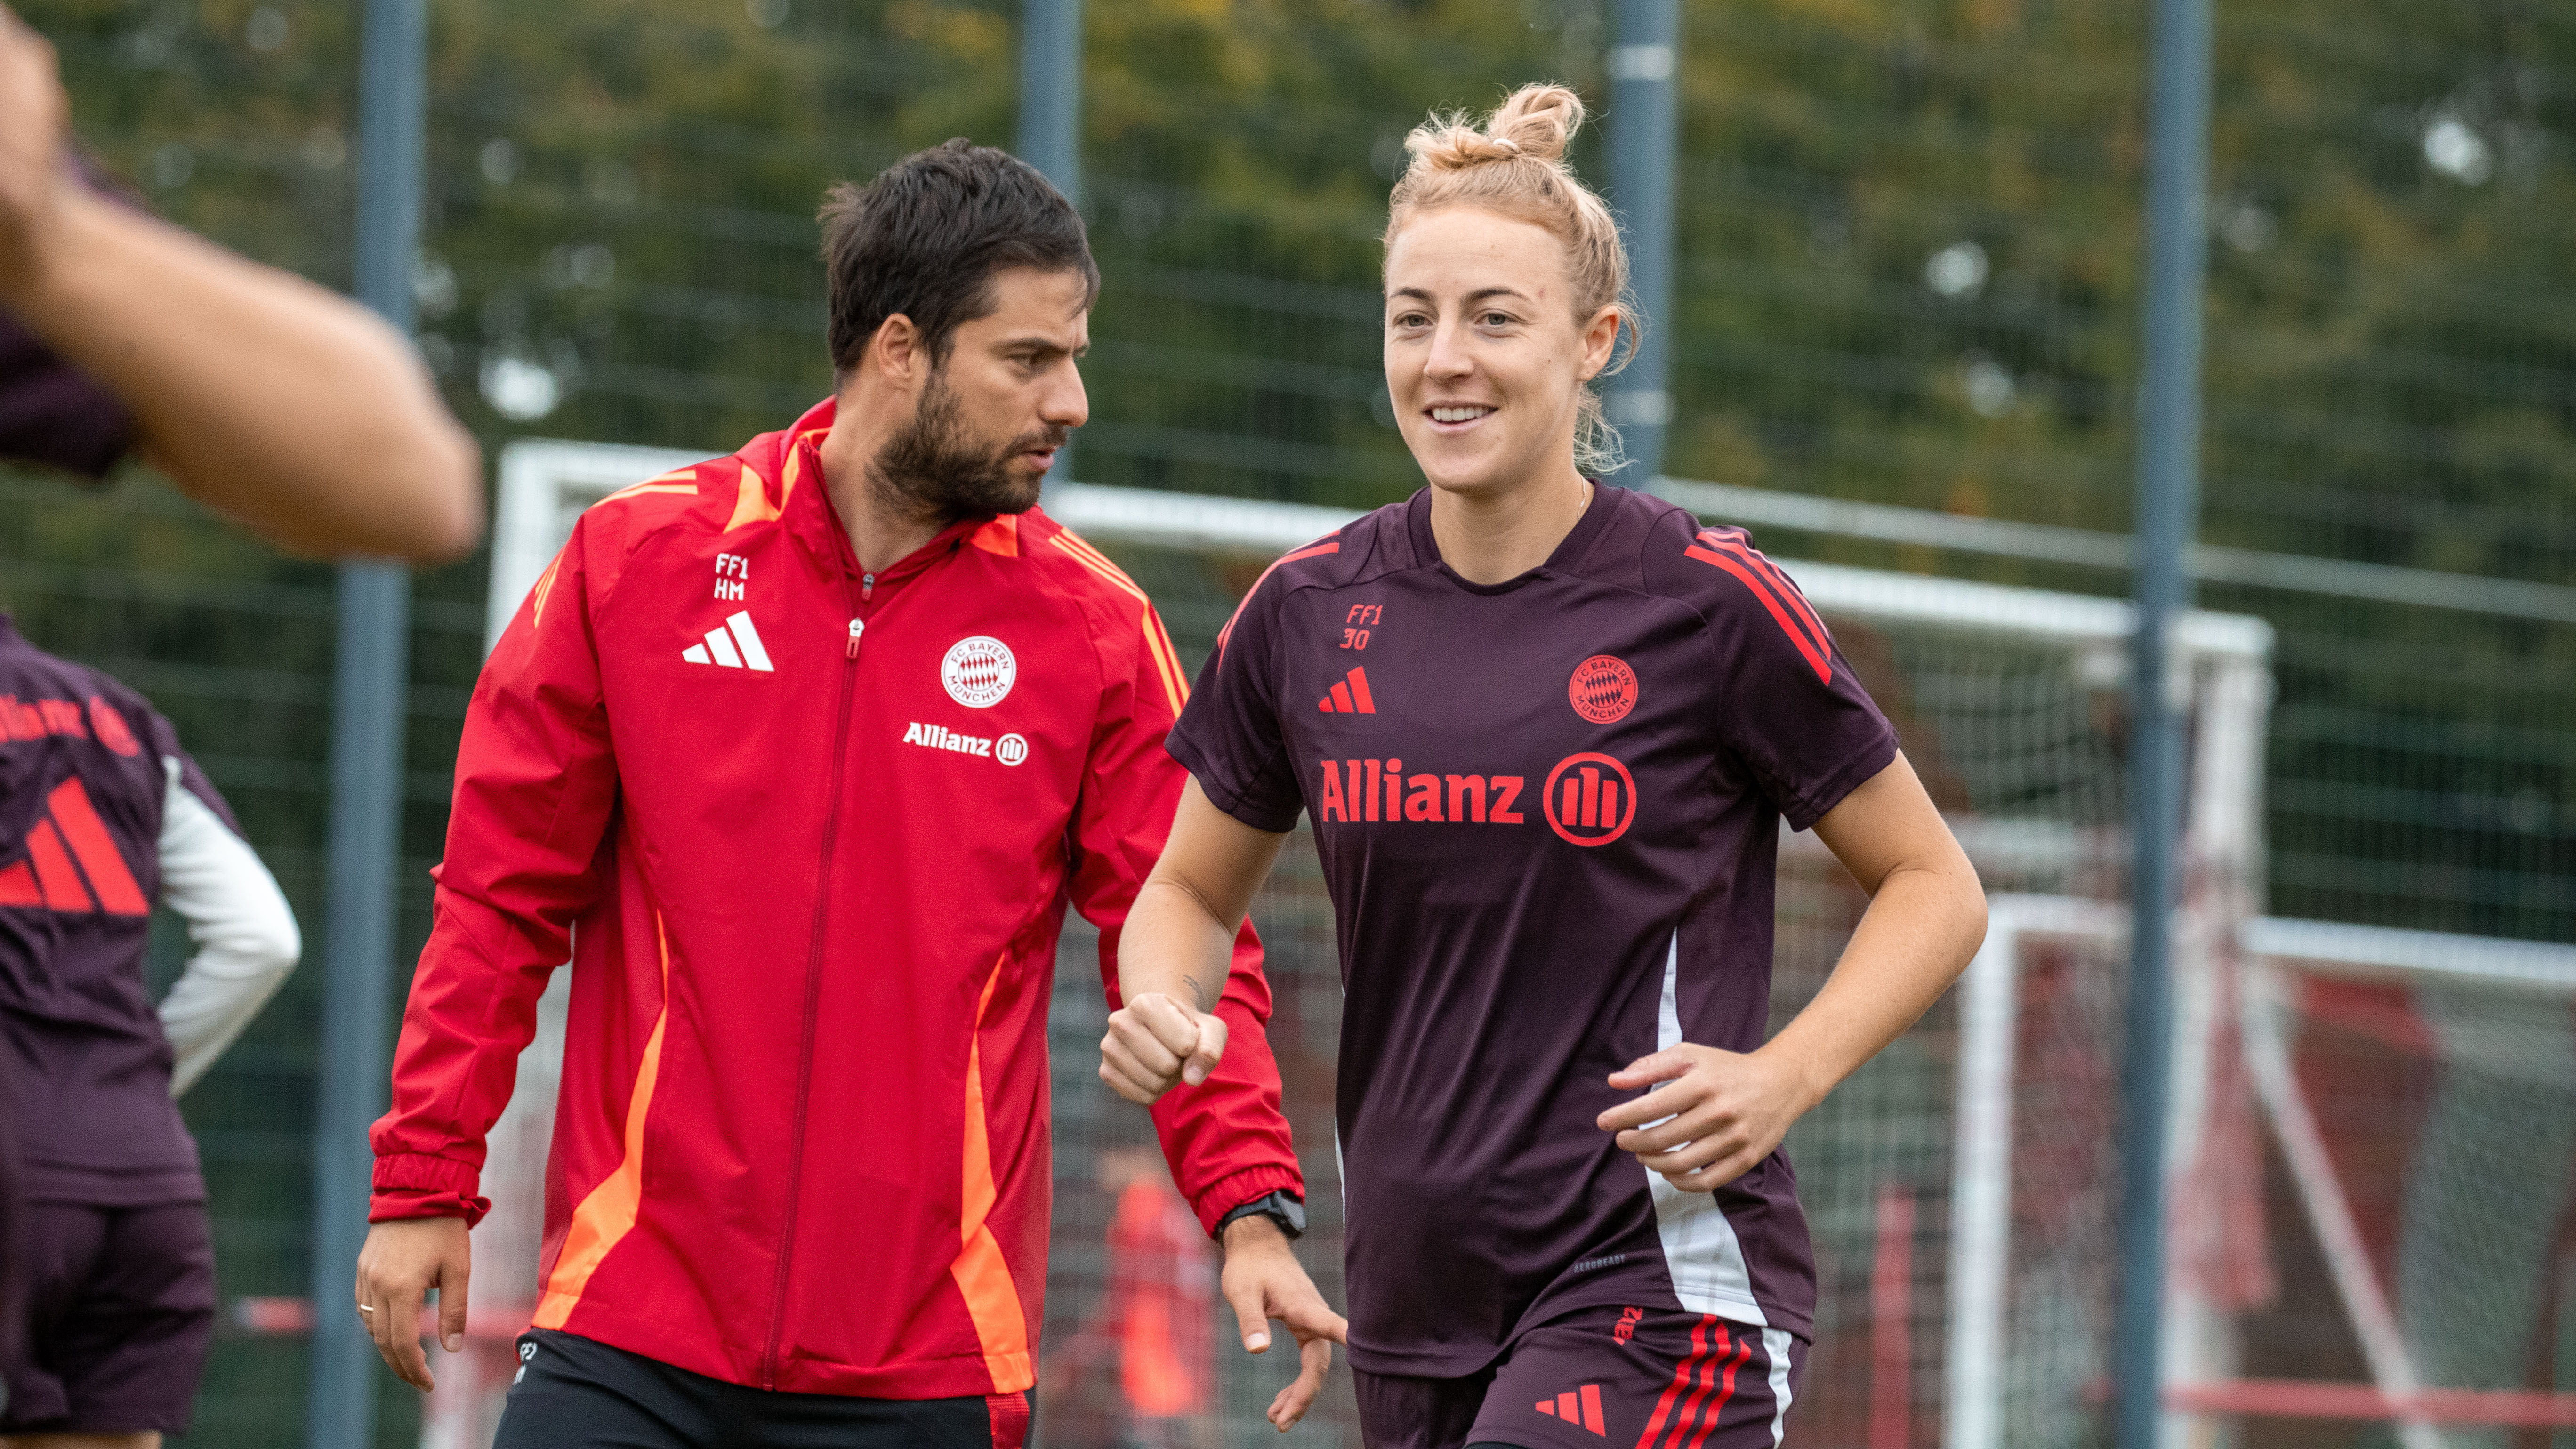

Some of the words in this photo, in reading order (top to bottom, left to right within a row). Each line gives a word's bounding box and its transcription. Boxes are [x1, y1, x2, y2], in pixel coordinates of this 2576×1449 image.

[716, 553, 749, 580] FF1
[714, 577, 745, 600] HM
[1346, 604, 1383, 625] FF1
[1339, 628, 1370, 650] 30
[951, 649, 965, 663] FC
[968, 642, 1009, 669] BAYERN
[1577, 668, 1589, 683] FC
[1591, 660, 1632, 686] BAYERN
[903, 722, 992, 757] Allianz
[1321, 758, 1524, 824] Allianz
